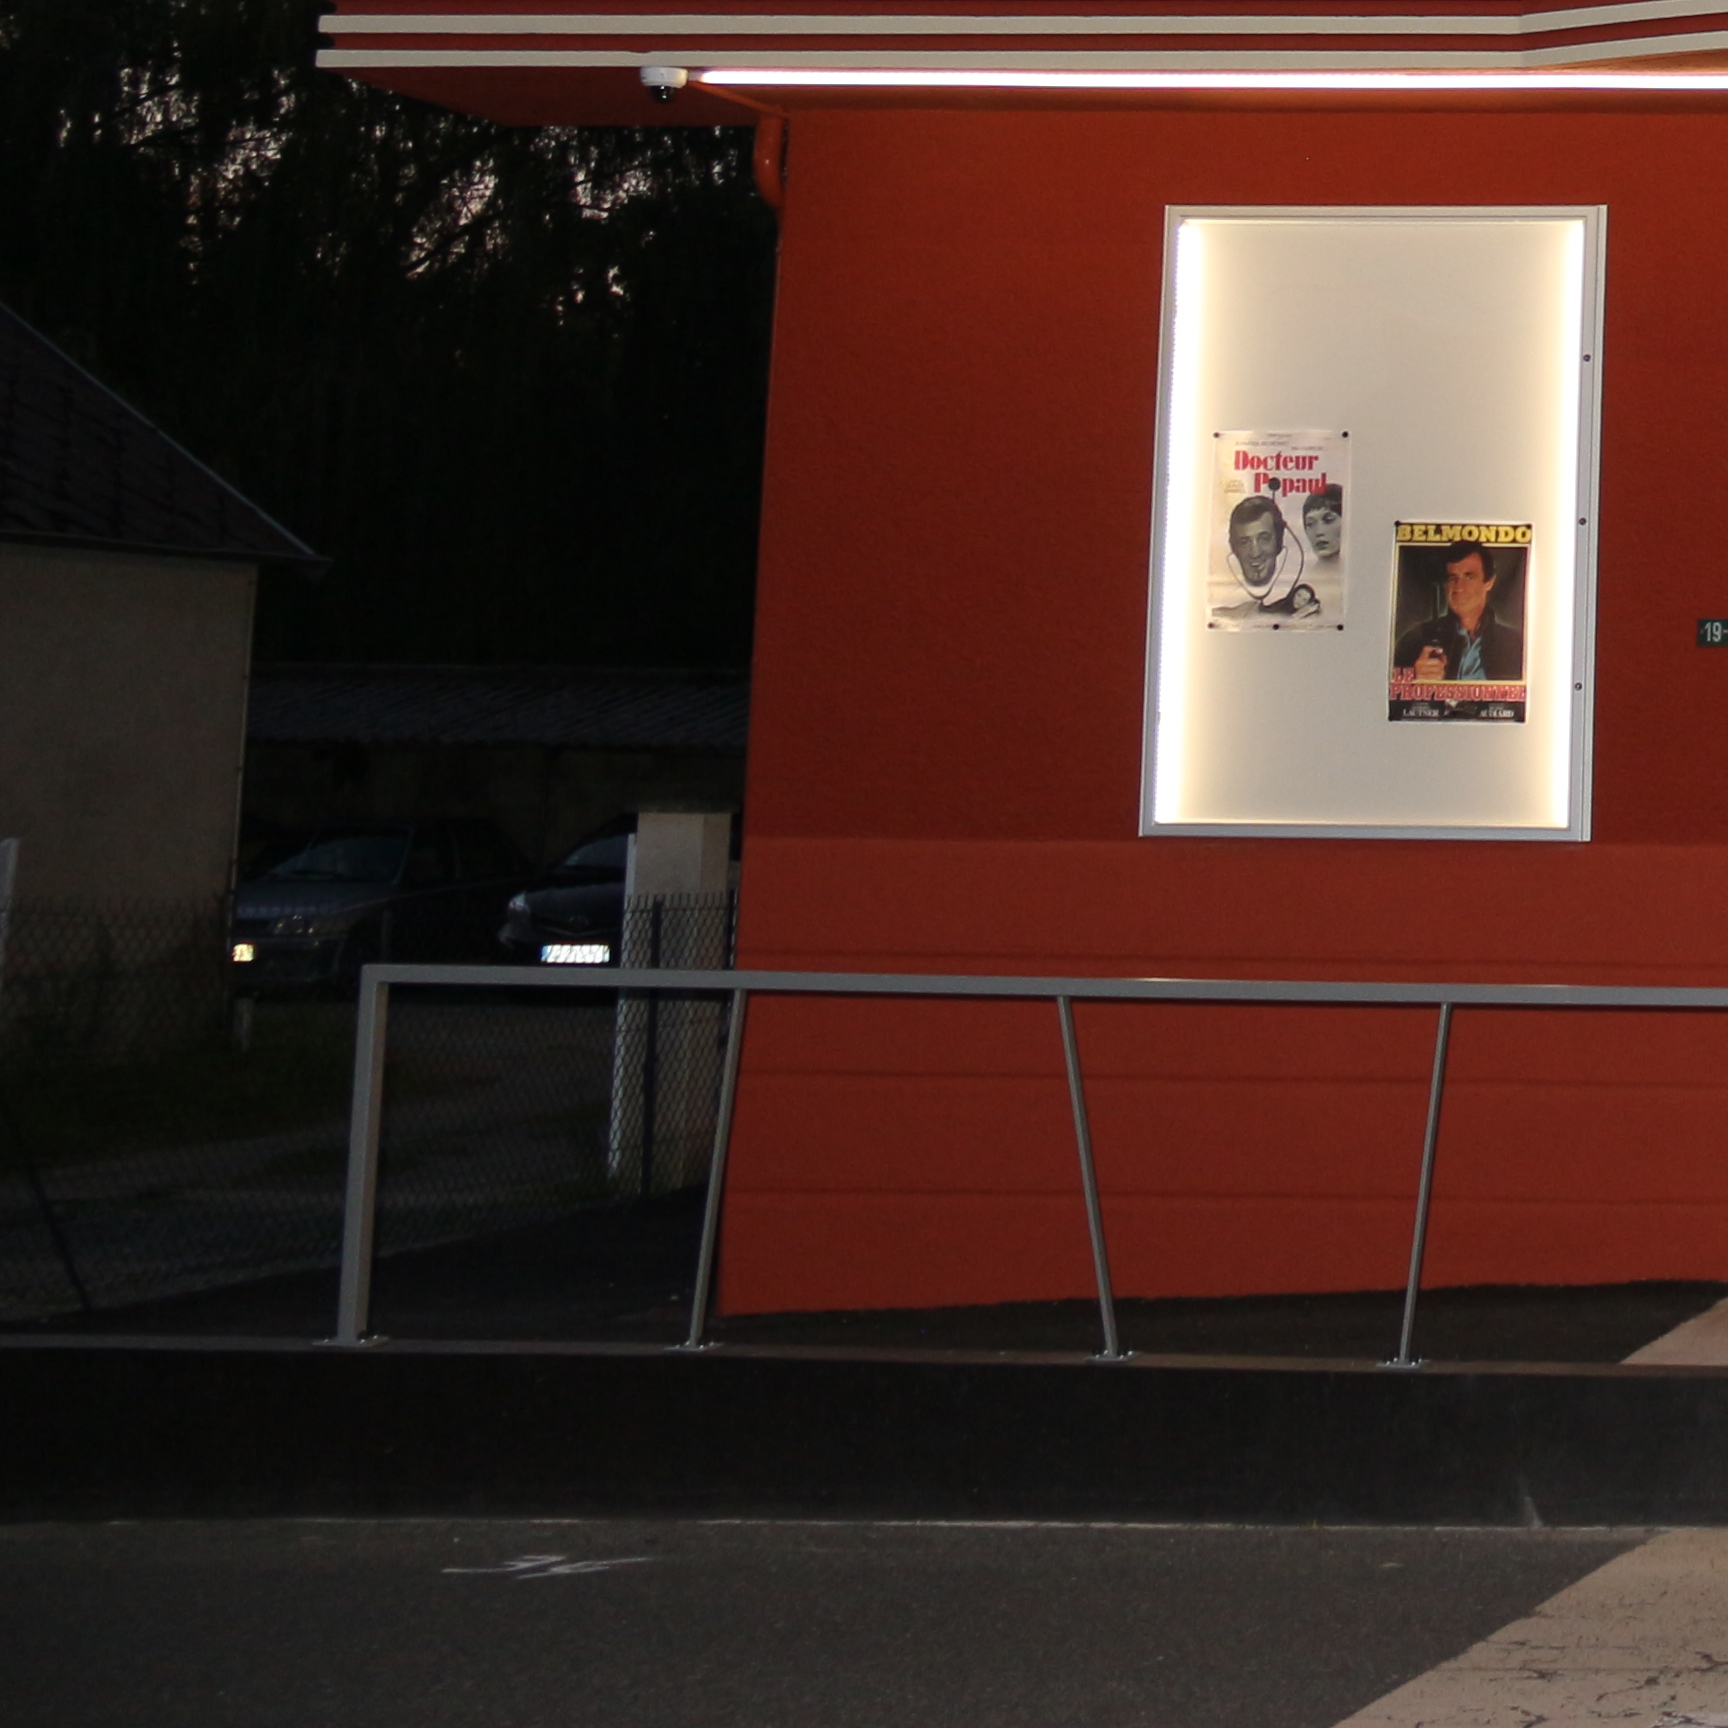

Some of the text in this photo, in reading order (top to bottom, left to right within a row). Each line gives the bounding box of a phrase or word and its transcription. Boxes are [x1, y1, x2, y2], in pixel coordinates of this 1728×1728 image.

[1233, 450, 1319, 471] Docteur
[1396, 524, 1532, 543] BELMONDO
[1704, 621, 1723, 643] 19
[1391, 666, 1415, 684] LE
[1389, 683, 1527, 702] PROFESSIONNEL
